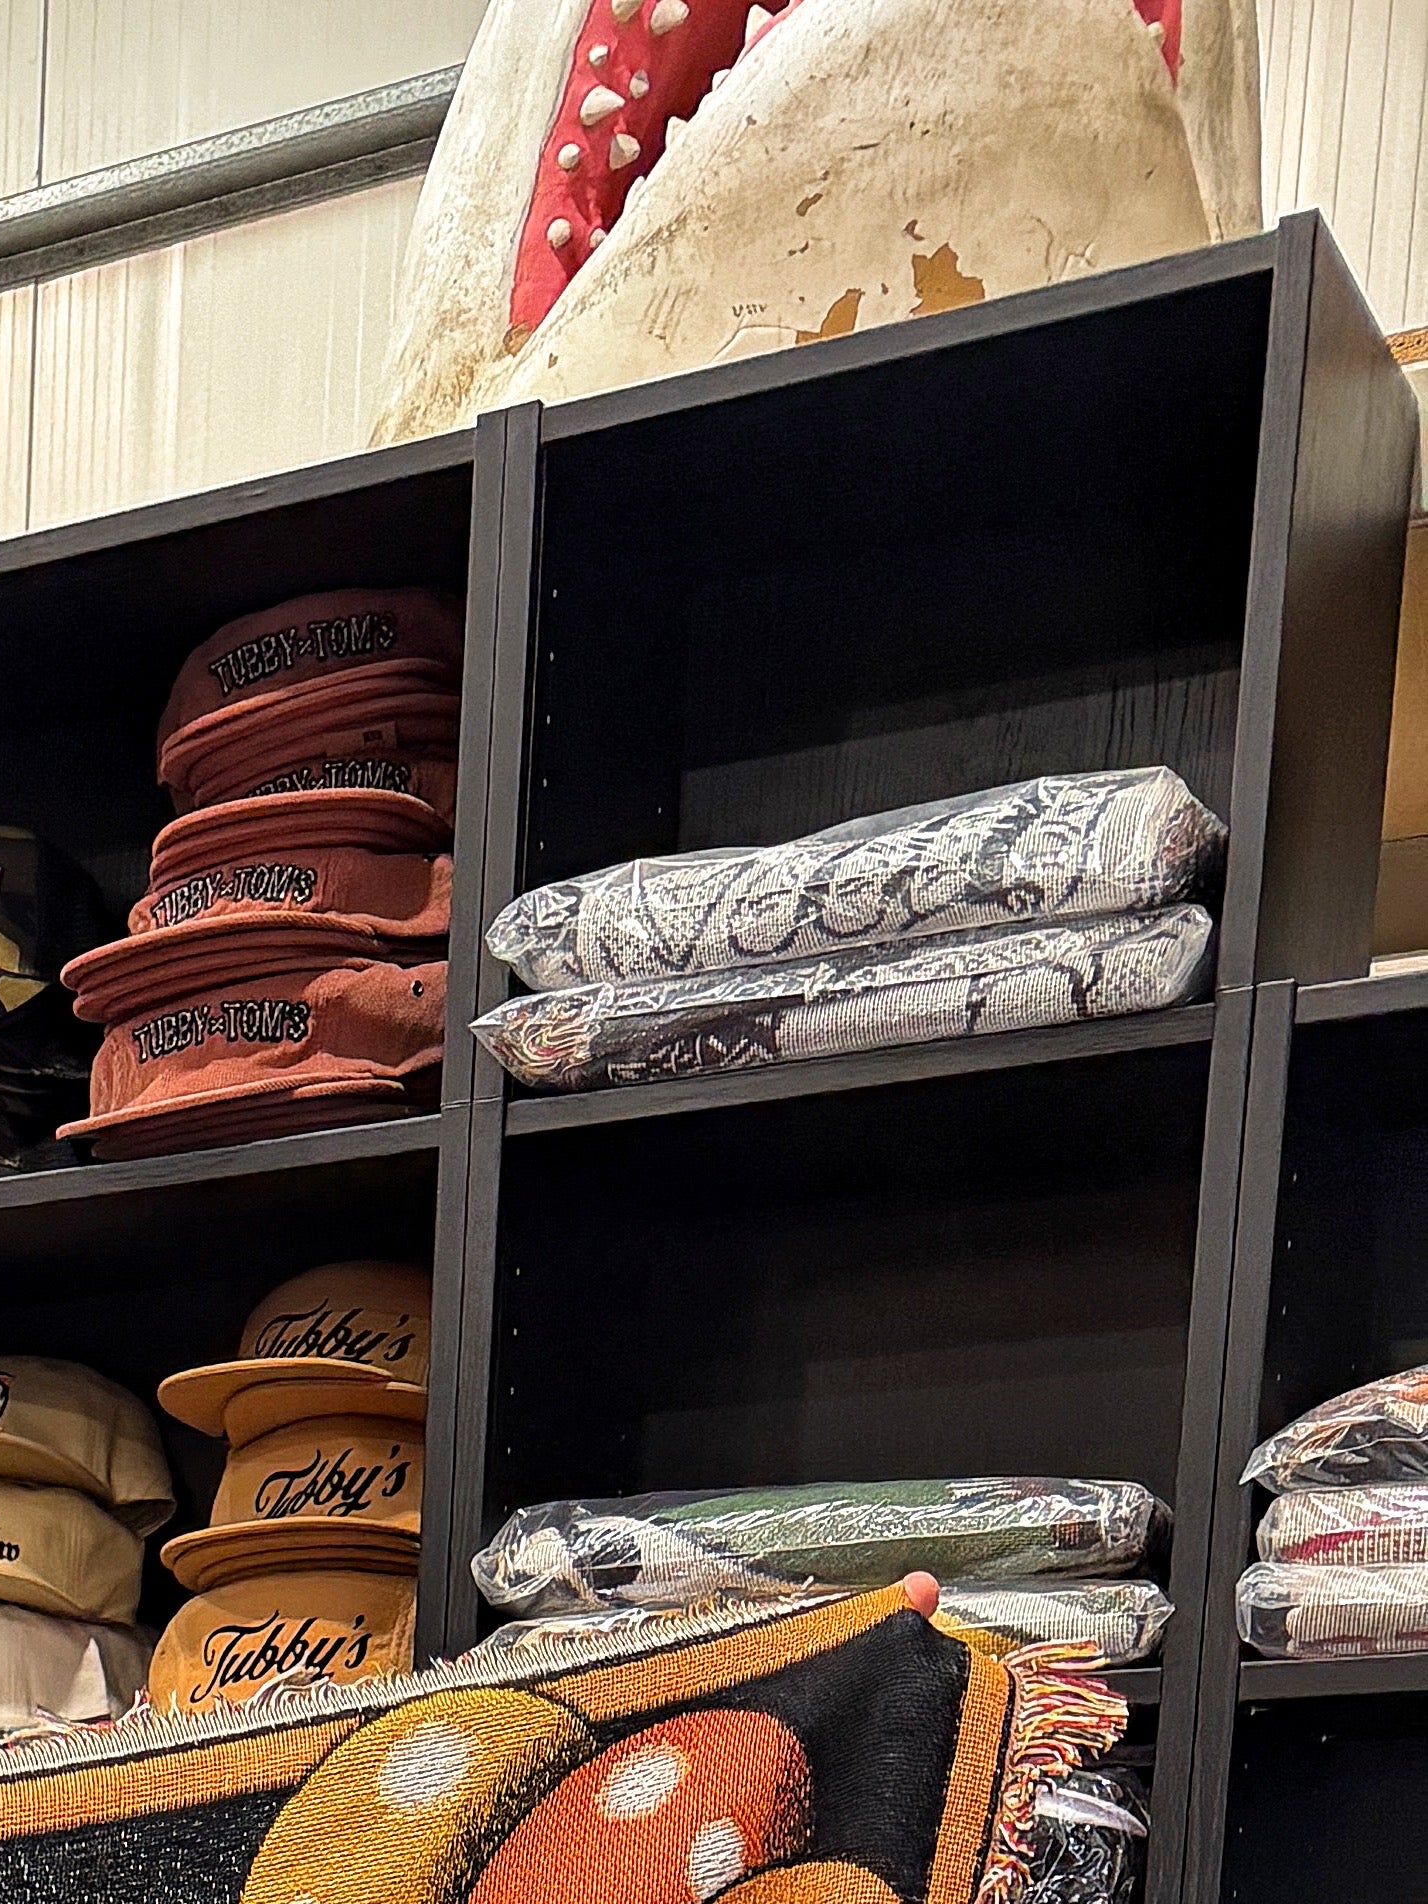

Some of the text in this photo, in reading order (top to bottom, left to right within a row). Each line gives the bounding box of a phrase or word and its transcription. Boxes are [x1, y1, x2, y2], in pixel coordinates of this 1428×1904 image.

[209, 614, 396, 696] TUBBY TOM'S
[151, 864, 317, 929] TUBBY TOM'S
[133, 999, 311, 1063] TUBBY TOM'S
[255, 1300, 418, 1364] Tubby's
[255, 1446, 412, 1520] Tubby's
[188, 1608, 376, 1706] Tubby's
